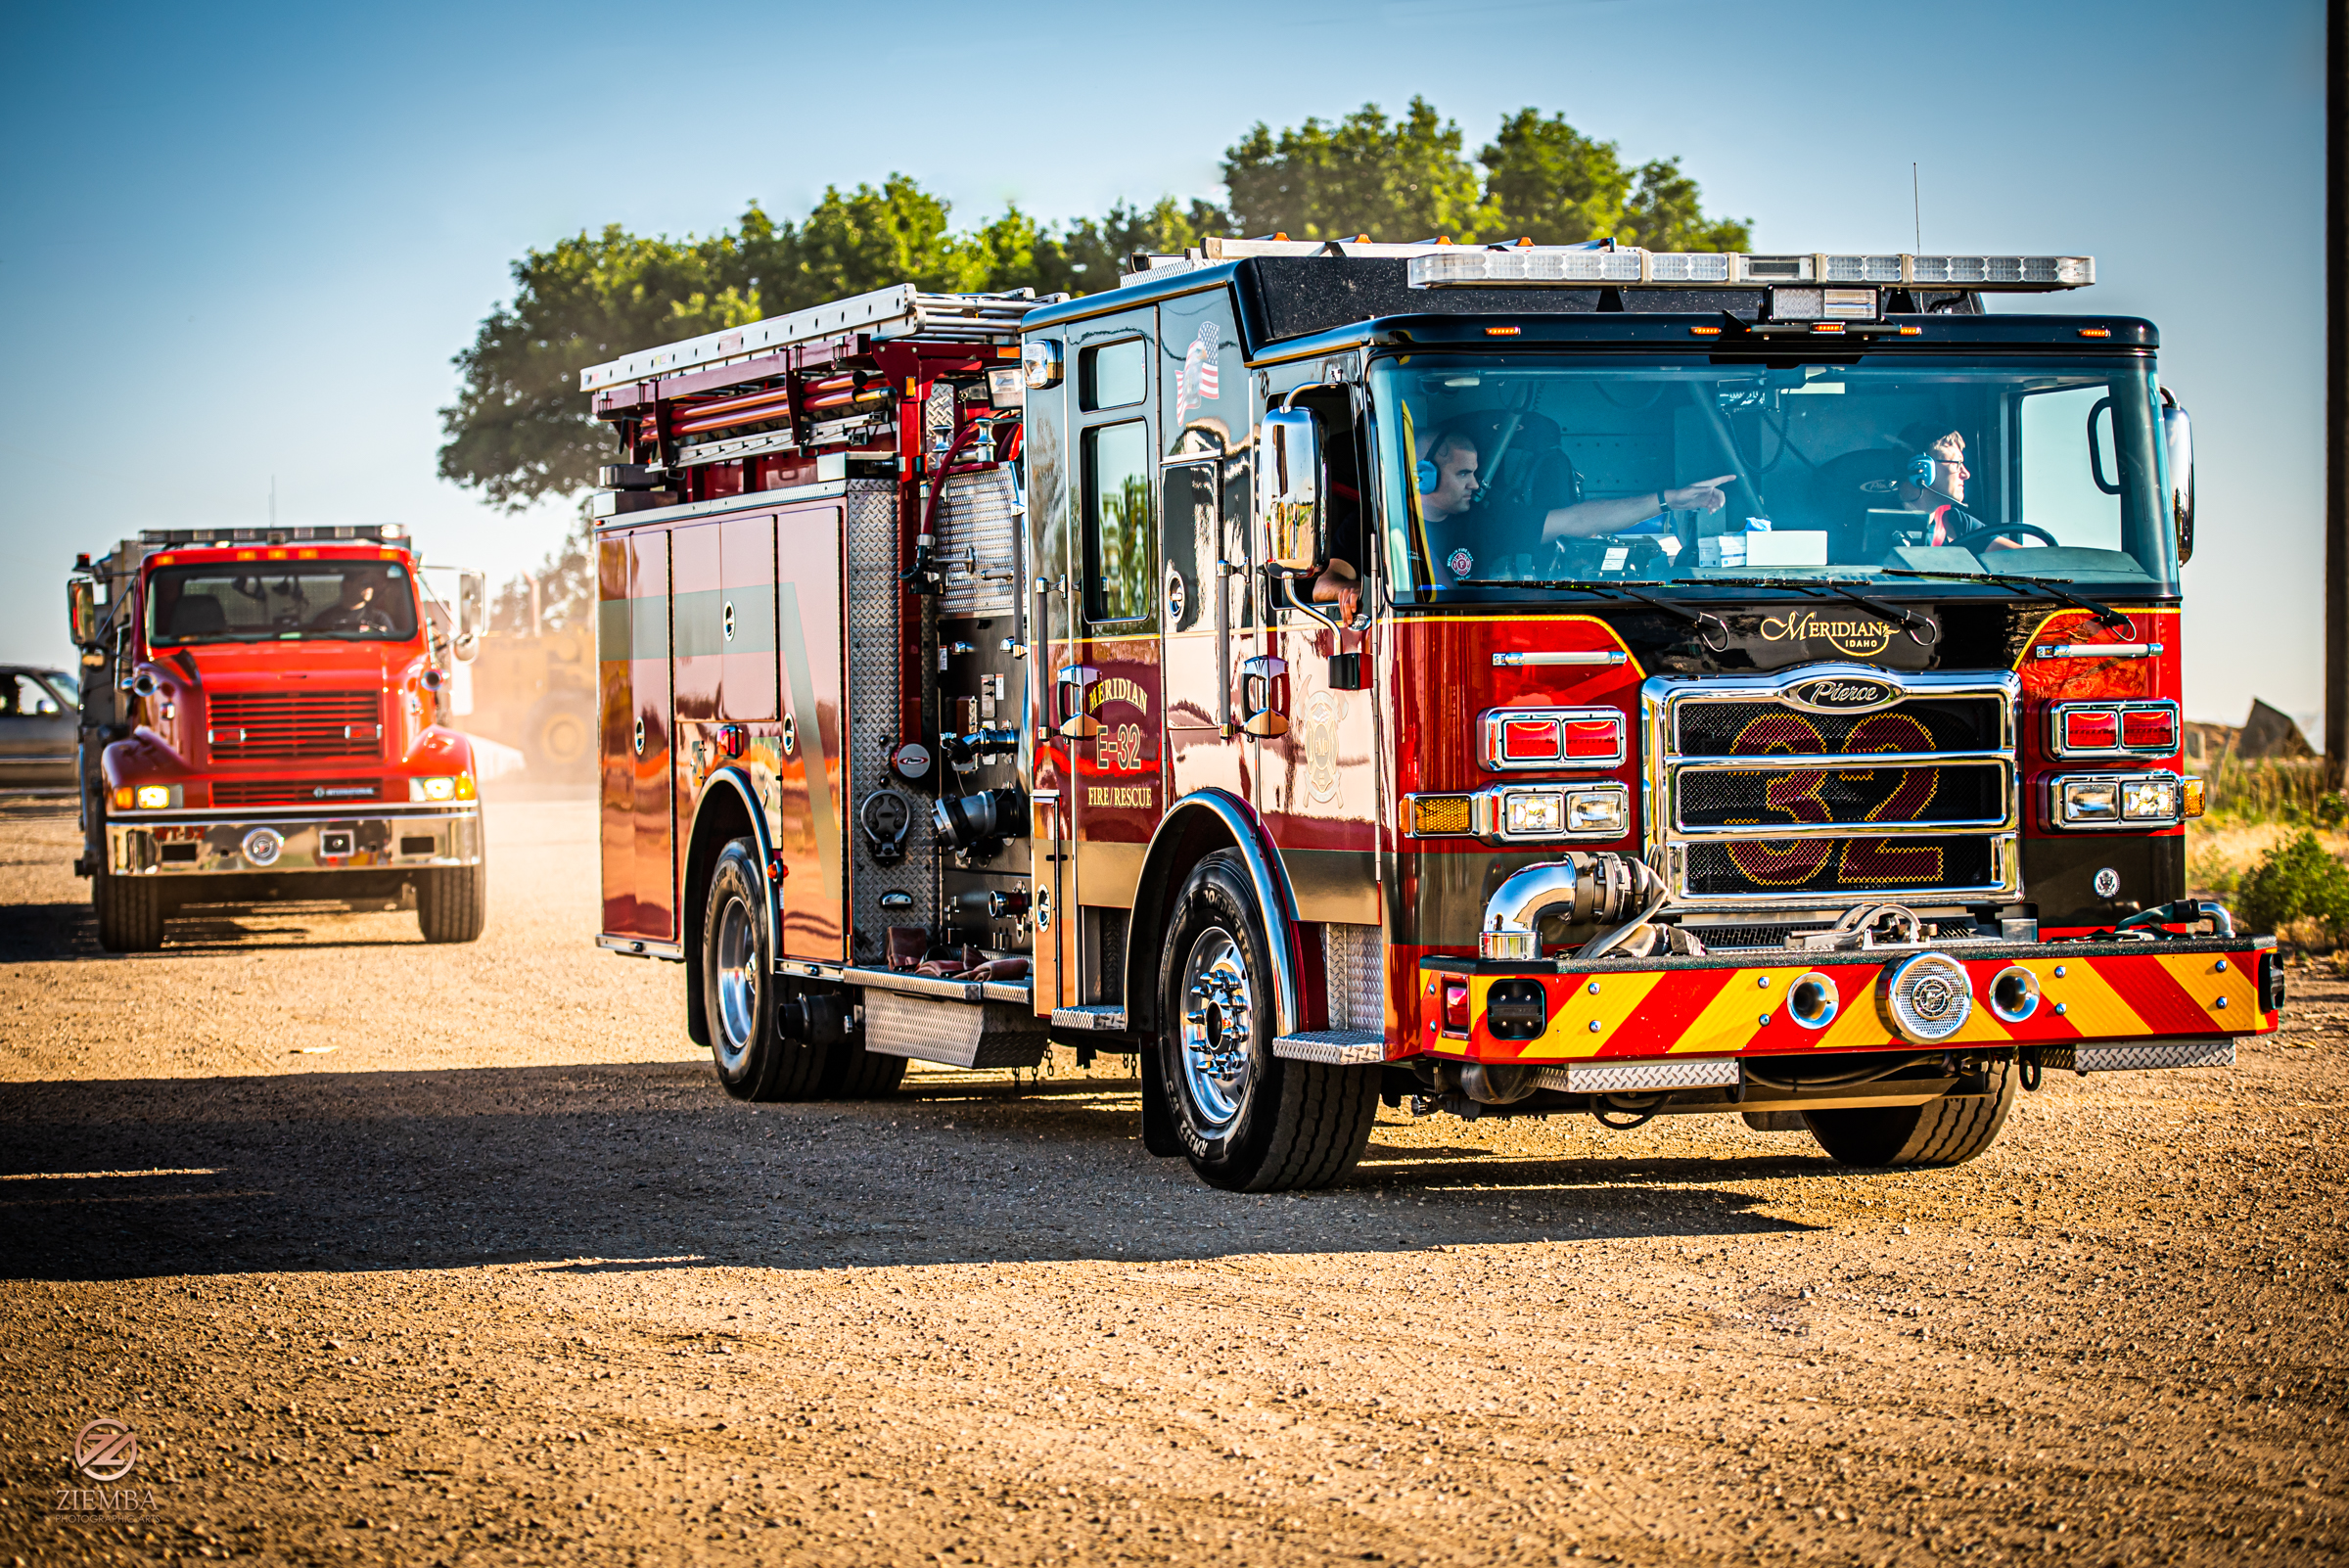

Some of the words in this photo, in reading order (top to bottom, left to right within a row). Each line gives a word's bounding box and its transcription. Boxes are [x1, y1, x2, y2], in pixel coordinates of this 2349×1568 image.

[1760, 610, 1885, 642] MERIDIAN
[1845, 639, 1878, 648] IDAHO
[1088, 676, 1148, 716] MERIDIAN
[1810, 680, 1878, 705] Pierce
[1096, 723, 1141, 770] E-32
[1087, 786, 1152, 808] FIRE/RESCUE
[1724, 712, 1944, 886] 32
[154, 826, 207, 840] WT-32
